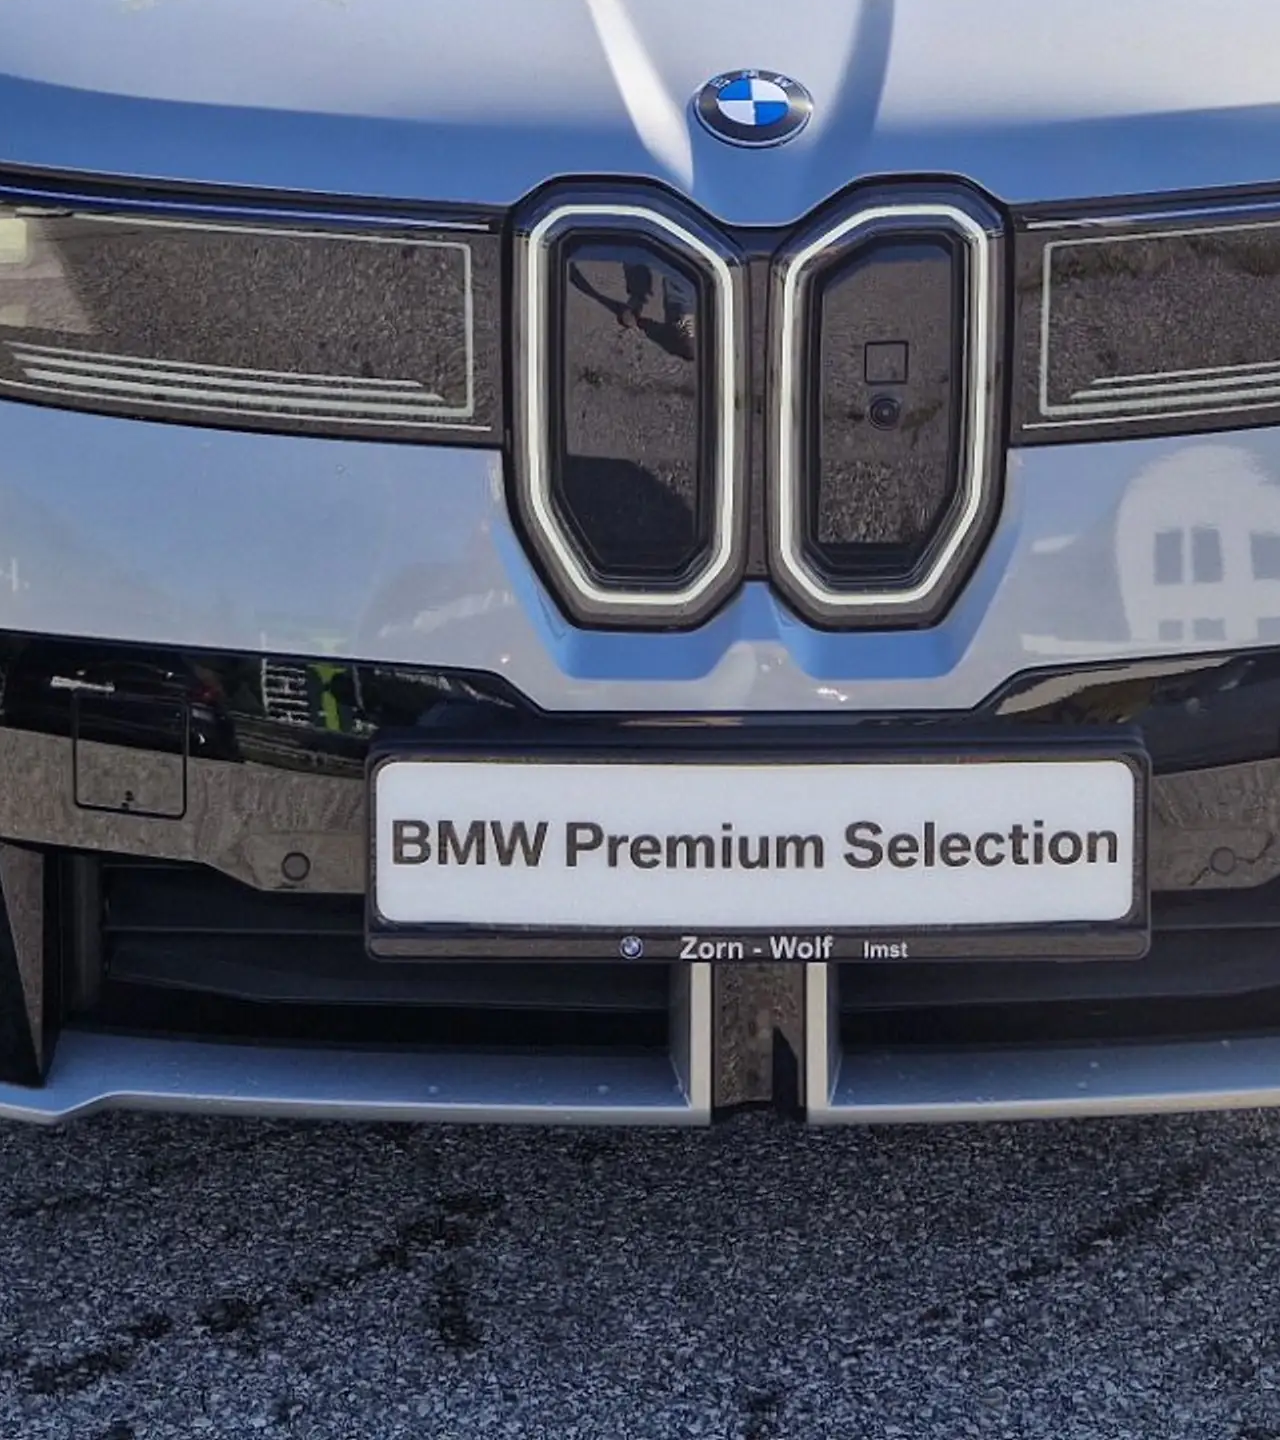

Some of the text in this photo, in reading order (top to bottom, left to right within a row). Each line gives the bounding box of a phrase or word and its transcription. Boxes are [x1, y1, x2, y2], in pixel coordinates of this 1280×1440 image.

[392, 819, 1118, 869] BMW Premium Selection
[680, 936, 743, 960] Zorn
[770, 935, 833, 960] Wolf
[863, 939, 909, 959] Imst
